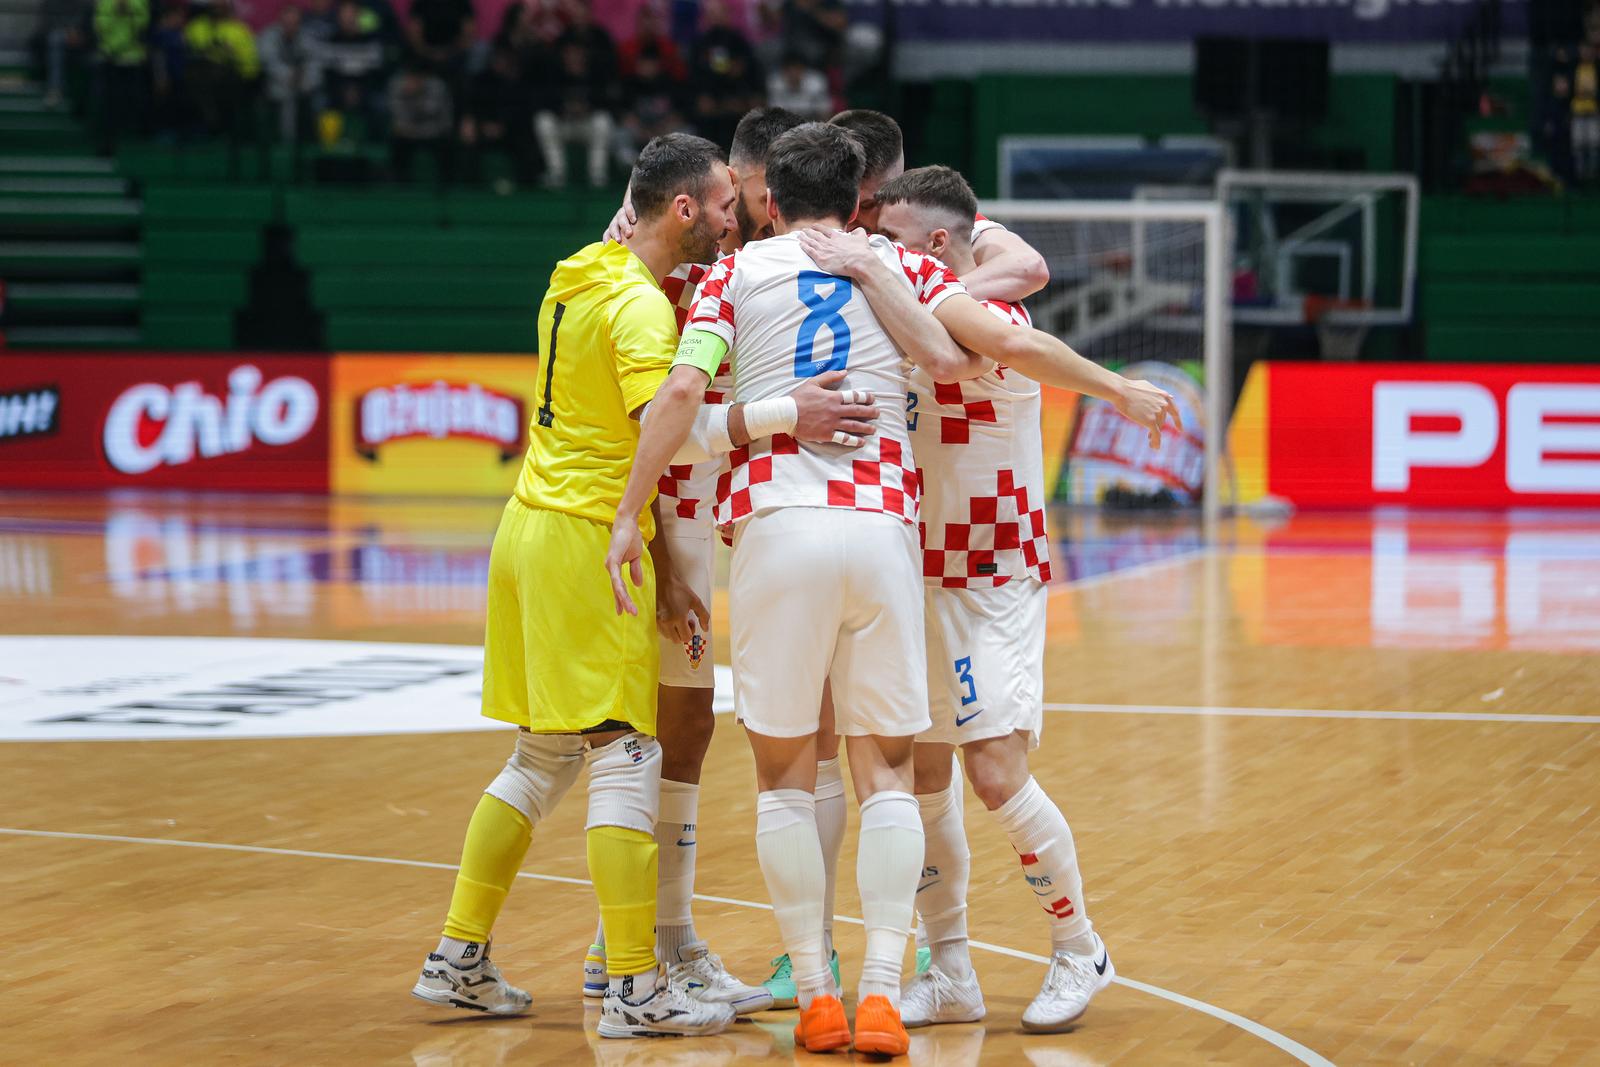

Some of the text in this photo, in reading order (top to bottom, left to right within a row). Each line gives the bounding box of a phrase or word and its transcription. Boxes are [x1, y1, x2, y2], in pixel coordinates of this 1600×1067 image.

[536, 301, 566, 428] 1
[794, 270, 852, 378] 8
[104, 365, 318, 474] Chio
[1372, 381, 1600, 493] PE
[955, 656, 978, 707] 3
